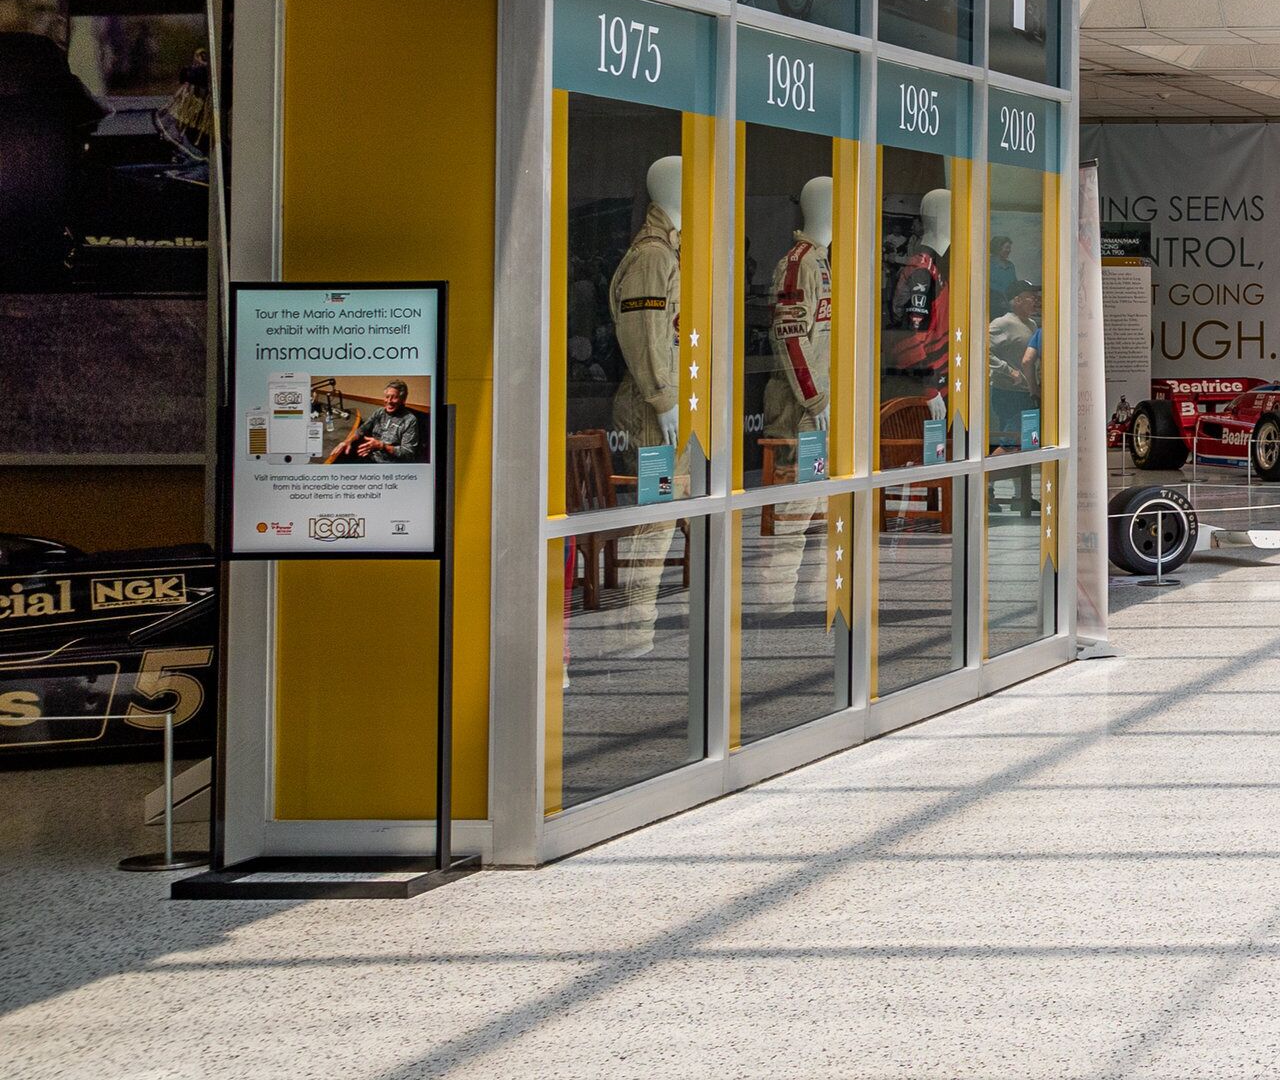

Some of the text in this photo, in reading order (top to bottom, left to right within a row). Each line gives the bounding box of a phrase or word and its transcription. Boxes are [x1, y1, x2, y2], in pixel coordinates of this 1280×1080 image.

[598, 14, 662, 83] 1975
[767, 53, 816, 113] 1981
[899, 84, 940, 137] 1985
[1001, 106, 1036, 153] 2018
[1168, 195, 1265, 222] SEEMS
[1168, 283, 1264, 306] GOING
[255, 308, 422, 319] Tour the Mario Andretti: ICON
[266, 324, 411, 336] exhibit with Mario himself!
[255, 343, 419, 361] imsmaudio.com
[1166, 380, 1243, 393] Beatrice
[254, 474, 269, 482] Visit
[309, 518, 365, 538] ICON
[96, 577, 182, 603] NGK
[124, 646, 214, 730] 5
